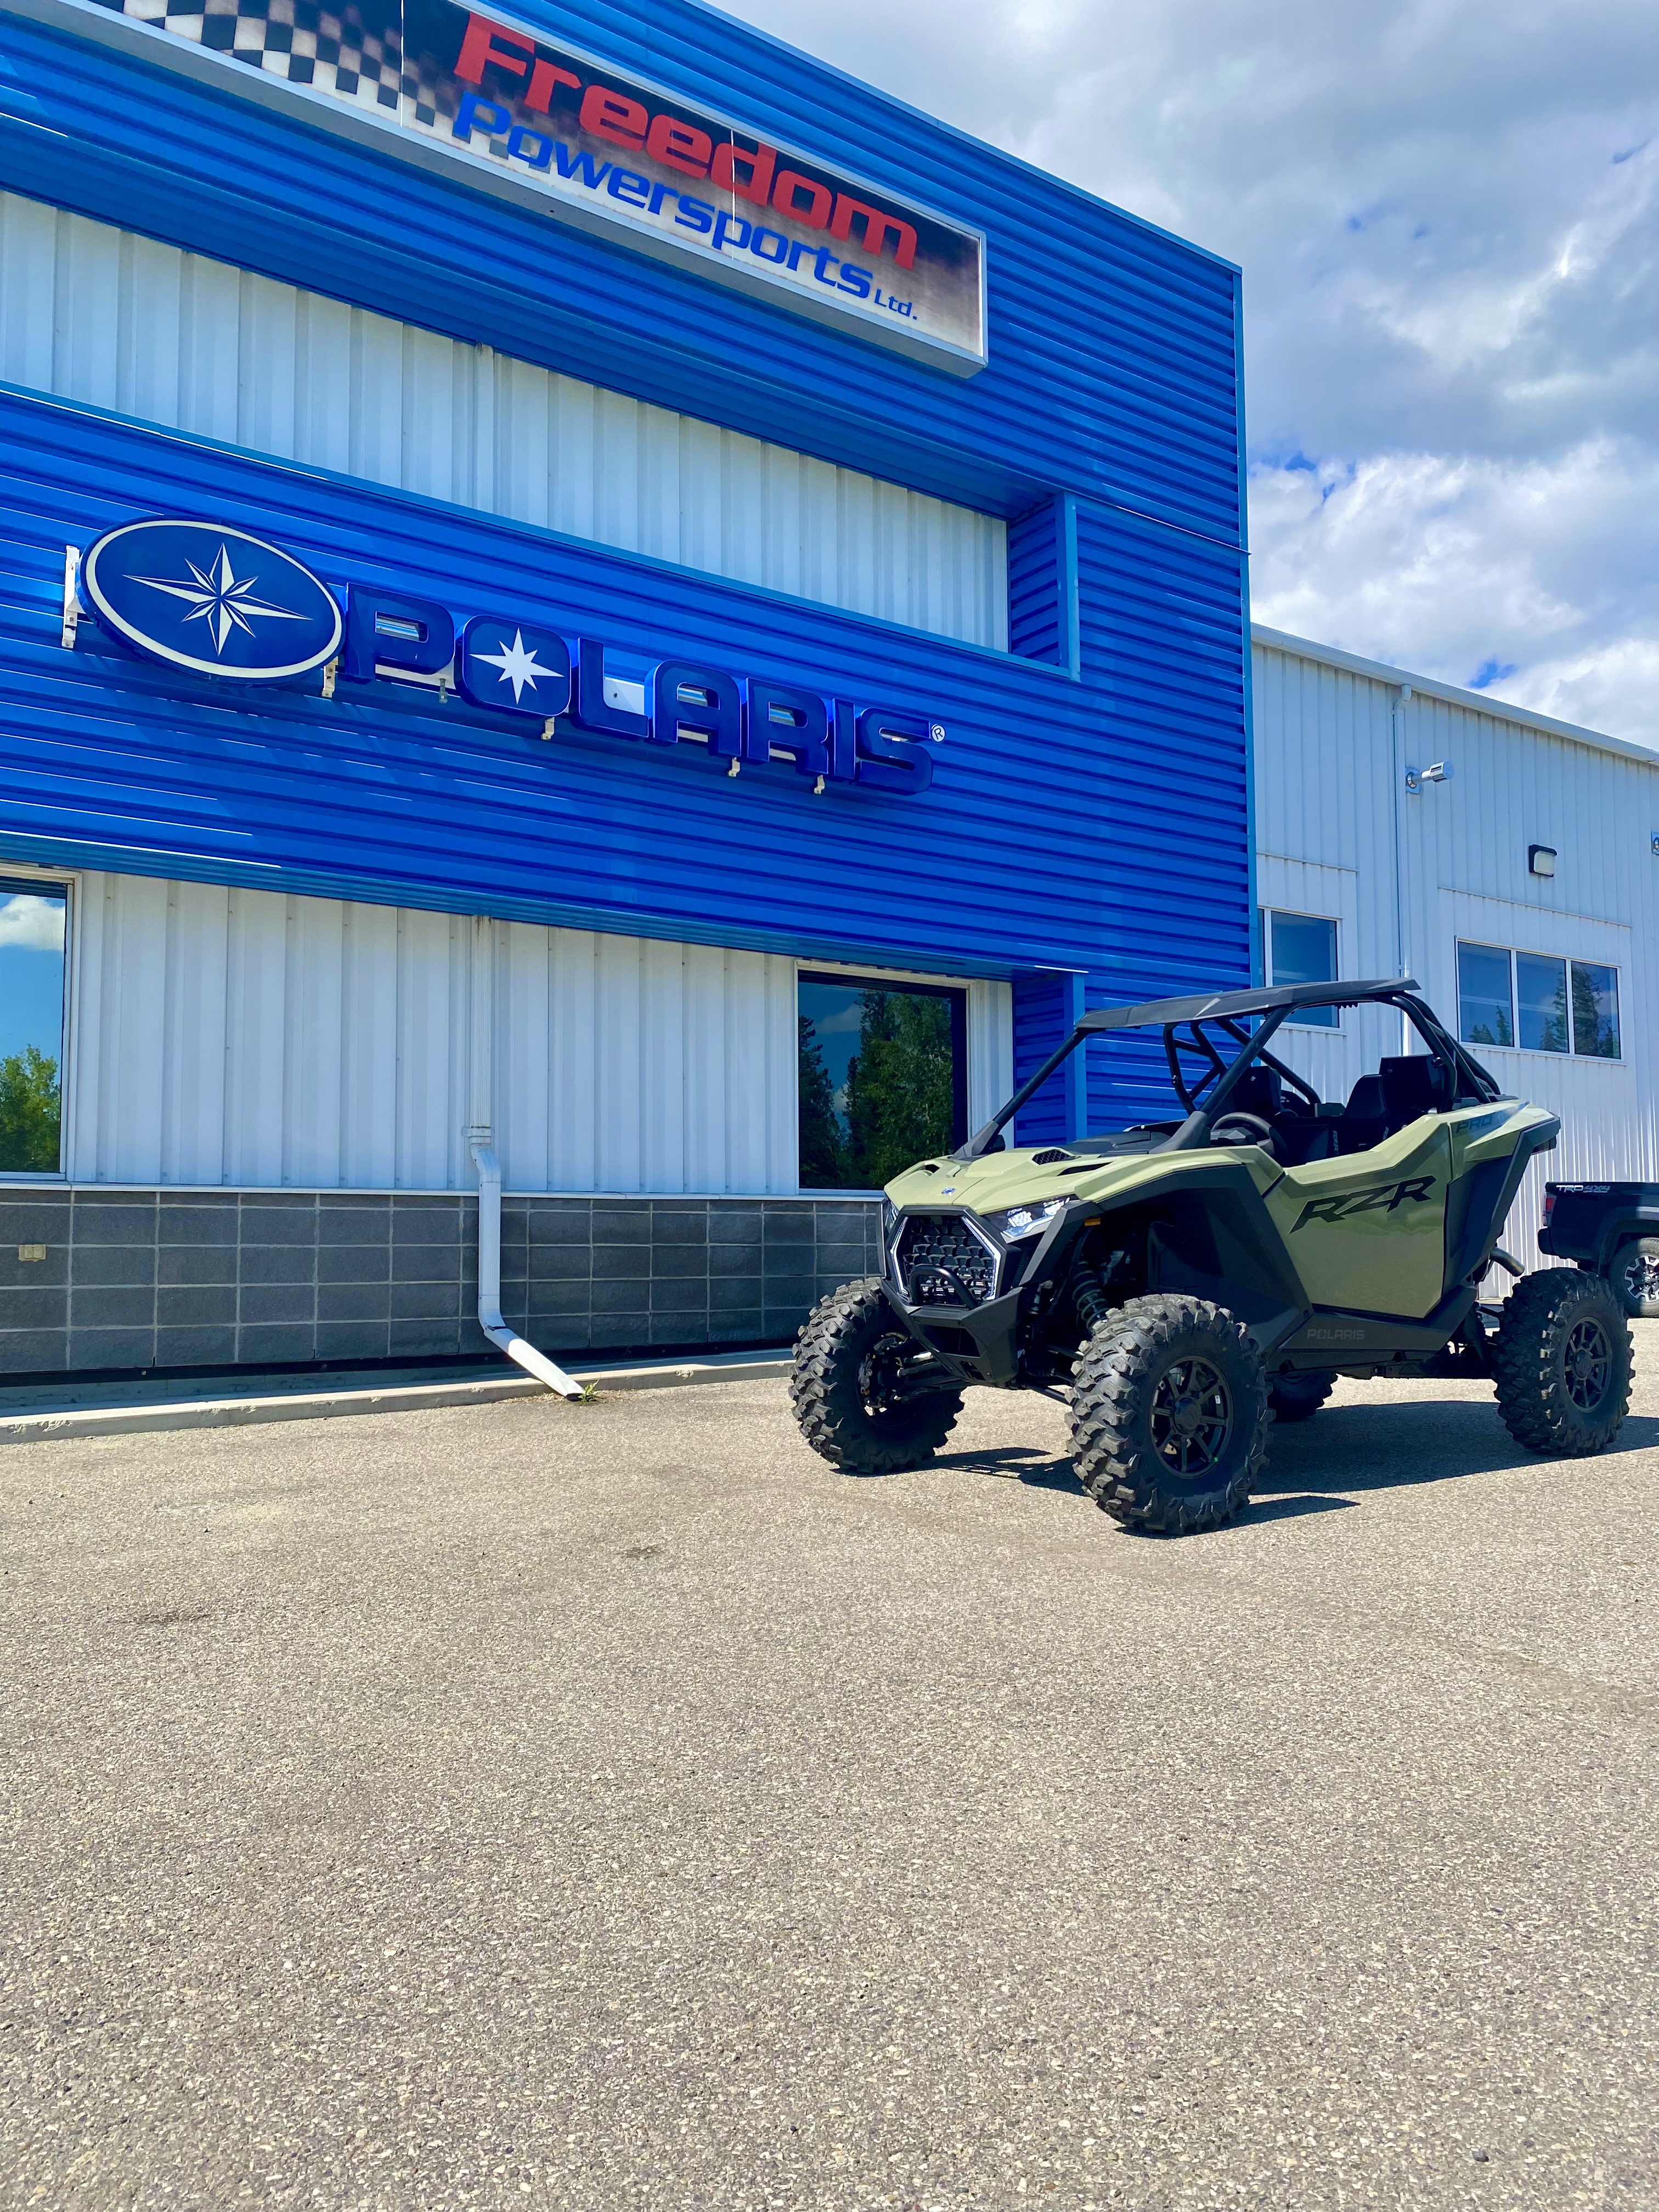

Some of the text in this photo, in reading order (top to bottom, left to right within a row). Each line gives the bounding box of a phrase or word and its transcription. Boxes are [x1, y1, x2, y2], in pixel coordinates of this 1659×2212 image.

[452, 92, 917, 320] Powersports Ltd.
[454, 12, 917, 270] Freedom
[1289, 1175, 1436, 1235] RZR
[1307, 1329, 1365, 1340] POLARIS
